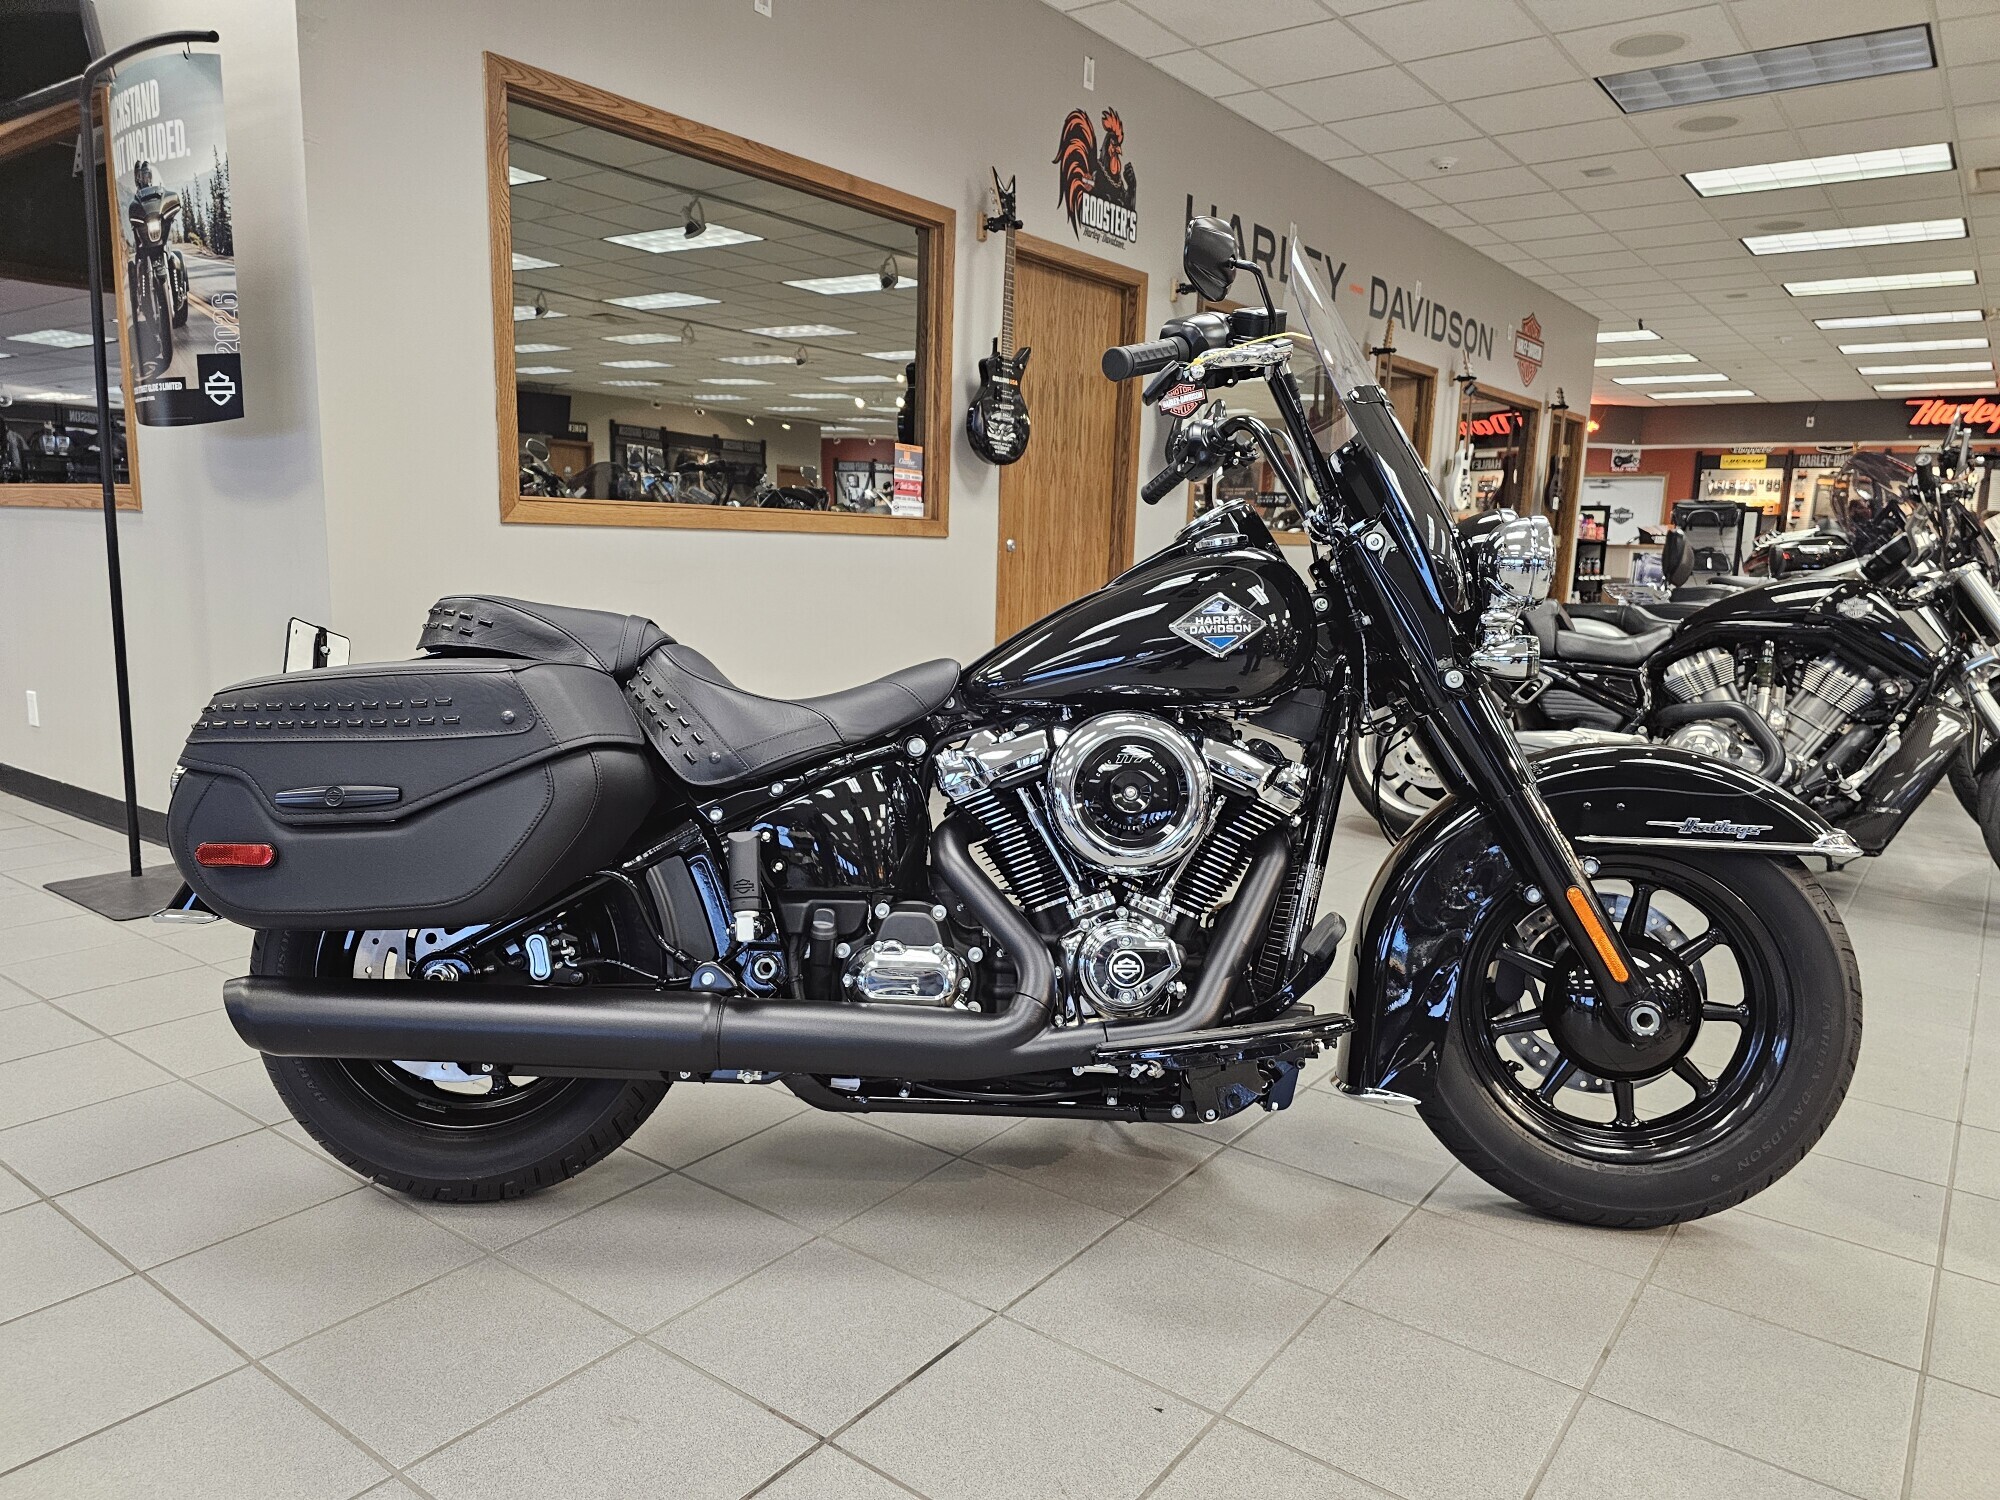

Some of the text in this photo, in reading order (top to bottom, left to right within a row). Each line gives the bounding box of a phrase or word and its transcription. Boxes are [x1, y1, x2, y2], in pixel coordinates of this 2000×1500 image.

[125, 119, 191, 172] INCLUDED.
[1081, 192, 1137, 243] ROOSTER'S
[211, 292, 241, 355] 2026
[162, 381, 183, 391] LIMITED
[1169, 386, 1192, 397] MOTOR
[1172, 401, 1195, 414] CYCLES
[1195, 615, 1247, 625] HARLEY-
[1189, 624, 1251, 635] DAVIDSON
[1115, 753, 1145, 764] 117
[1678, 817, 1760, 839] Heritage
